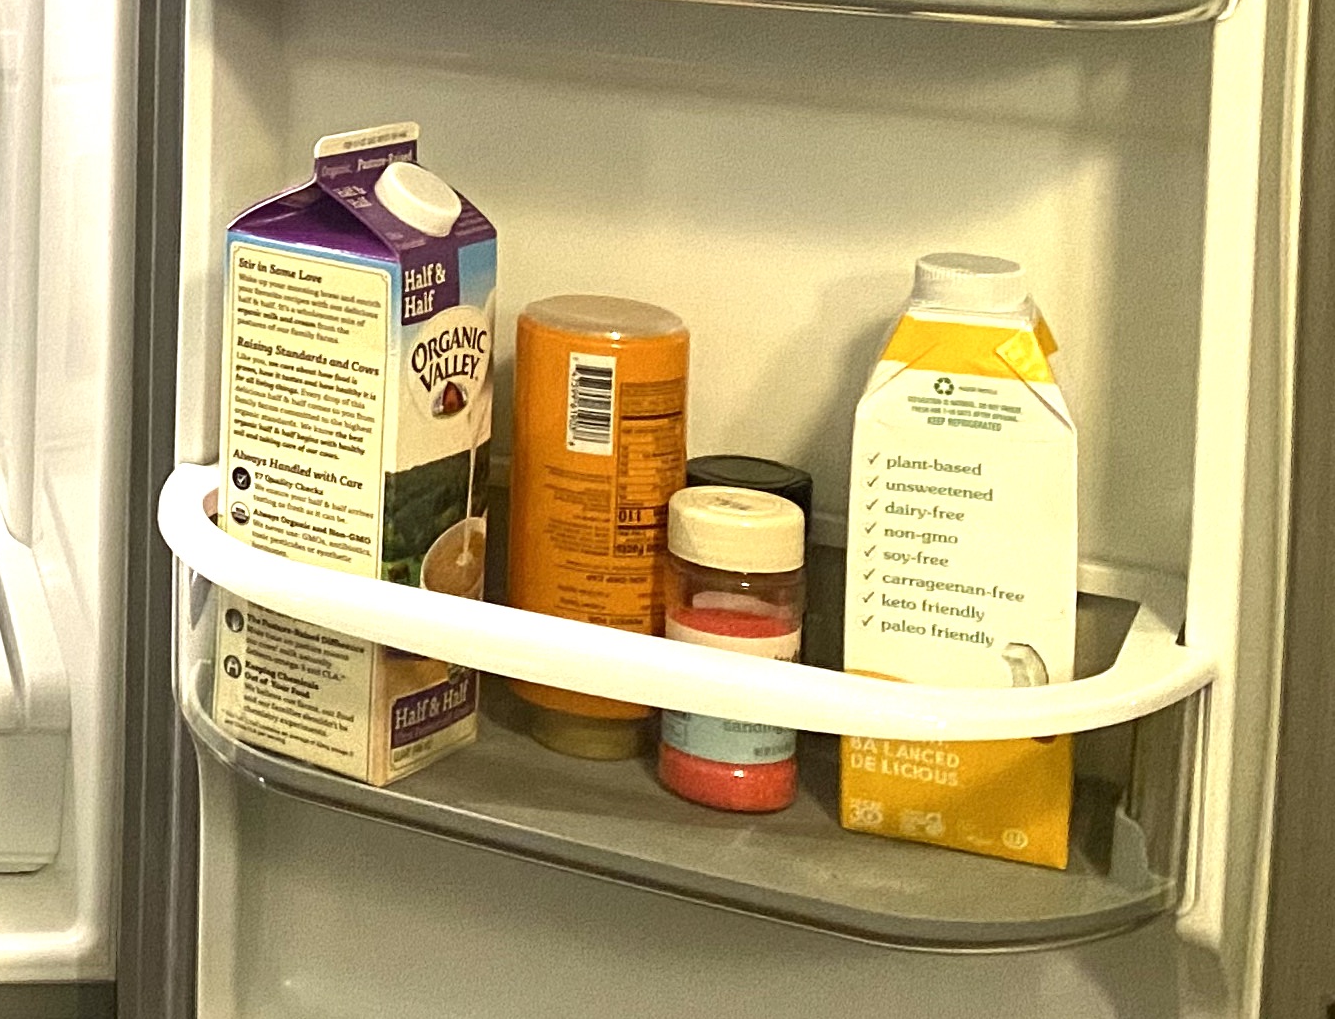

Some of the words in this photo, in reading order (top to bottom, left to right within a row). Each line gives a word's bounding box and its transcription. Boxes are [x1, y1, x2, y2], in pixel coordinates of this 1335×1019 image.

[238, 258, 255, 269] Stir
[257, 261, 267, 272] in
[270, 264, 296, 279] Some
[299, 270, 322, 283] Love
[404, 264, 435, 293] Half
[436, 262, 446, 284] &
[287, 284, 319, 297] morning
[344, 305, 378, 319] delicious
[404, 290, 435, 319] Half
[291, 327, 314, 340] family
[237, 336, 273, 355] Raising
[275, 345, 327, 364] Standards
[329, 357, 349, 369] and
[351, 361, 379, 376] Cows
[411, 326, 488, 374] ORGANIC
[296, 365, 316, 375] about
[335, 372, 351, 383] food
[420, 353, 480, 393] VALLEY
[301, 388, 321, 400] Every
[336, 384, 361, 397] healthy
[927, 416, 945, 425] KEEP
[947, 418, 1002, 432] REFRIGERATED
[233, 448, 267, 467] Always
[269, 458, 312, 478] Handled
[313, 470, 337, 484] with
[339, 475, 363, 489] Care
[886, 455, 982, 476] plant-based
[265, 474, 293, 490] Quality
[295, 482, 324, 495] Checks
[886, 481, 994, 502] unsweetened
[618, 509, 642, 523] 110
[885, 501, 965, 521] dairy-free
[253, 508, 279, 522] Always
[281, 516, 310, 530] Organic
[312, 523, 327, 534] and
[329, 527, 371, 544] Non-GMO
[884, 527, 958, 544] non-gmo
[302, 532, 328, 546] GMOs,
[883, 550, 949, 567] soy-free
[882, 573, 1025, 602] carrageenan-free
[881, 594, 917, 611] keto
[922, 599, 985, 622] friendly
[881, 620, 926, 636] paleo
[931, 624, 994, 648] friendly
[291, 687, 310, 698] Food
[395, 699, 429, 729] Half
[430, 696, 440, 717] &
[443, 678, 469, 711] Half
[851, 754, 876, 772] DE
[882, 759, 959, 786] LICIOUS
